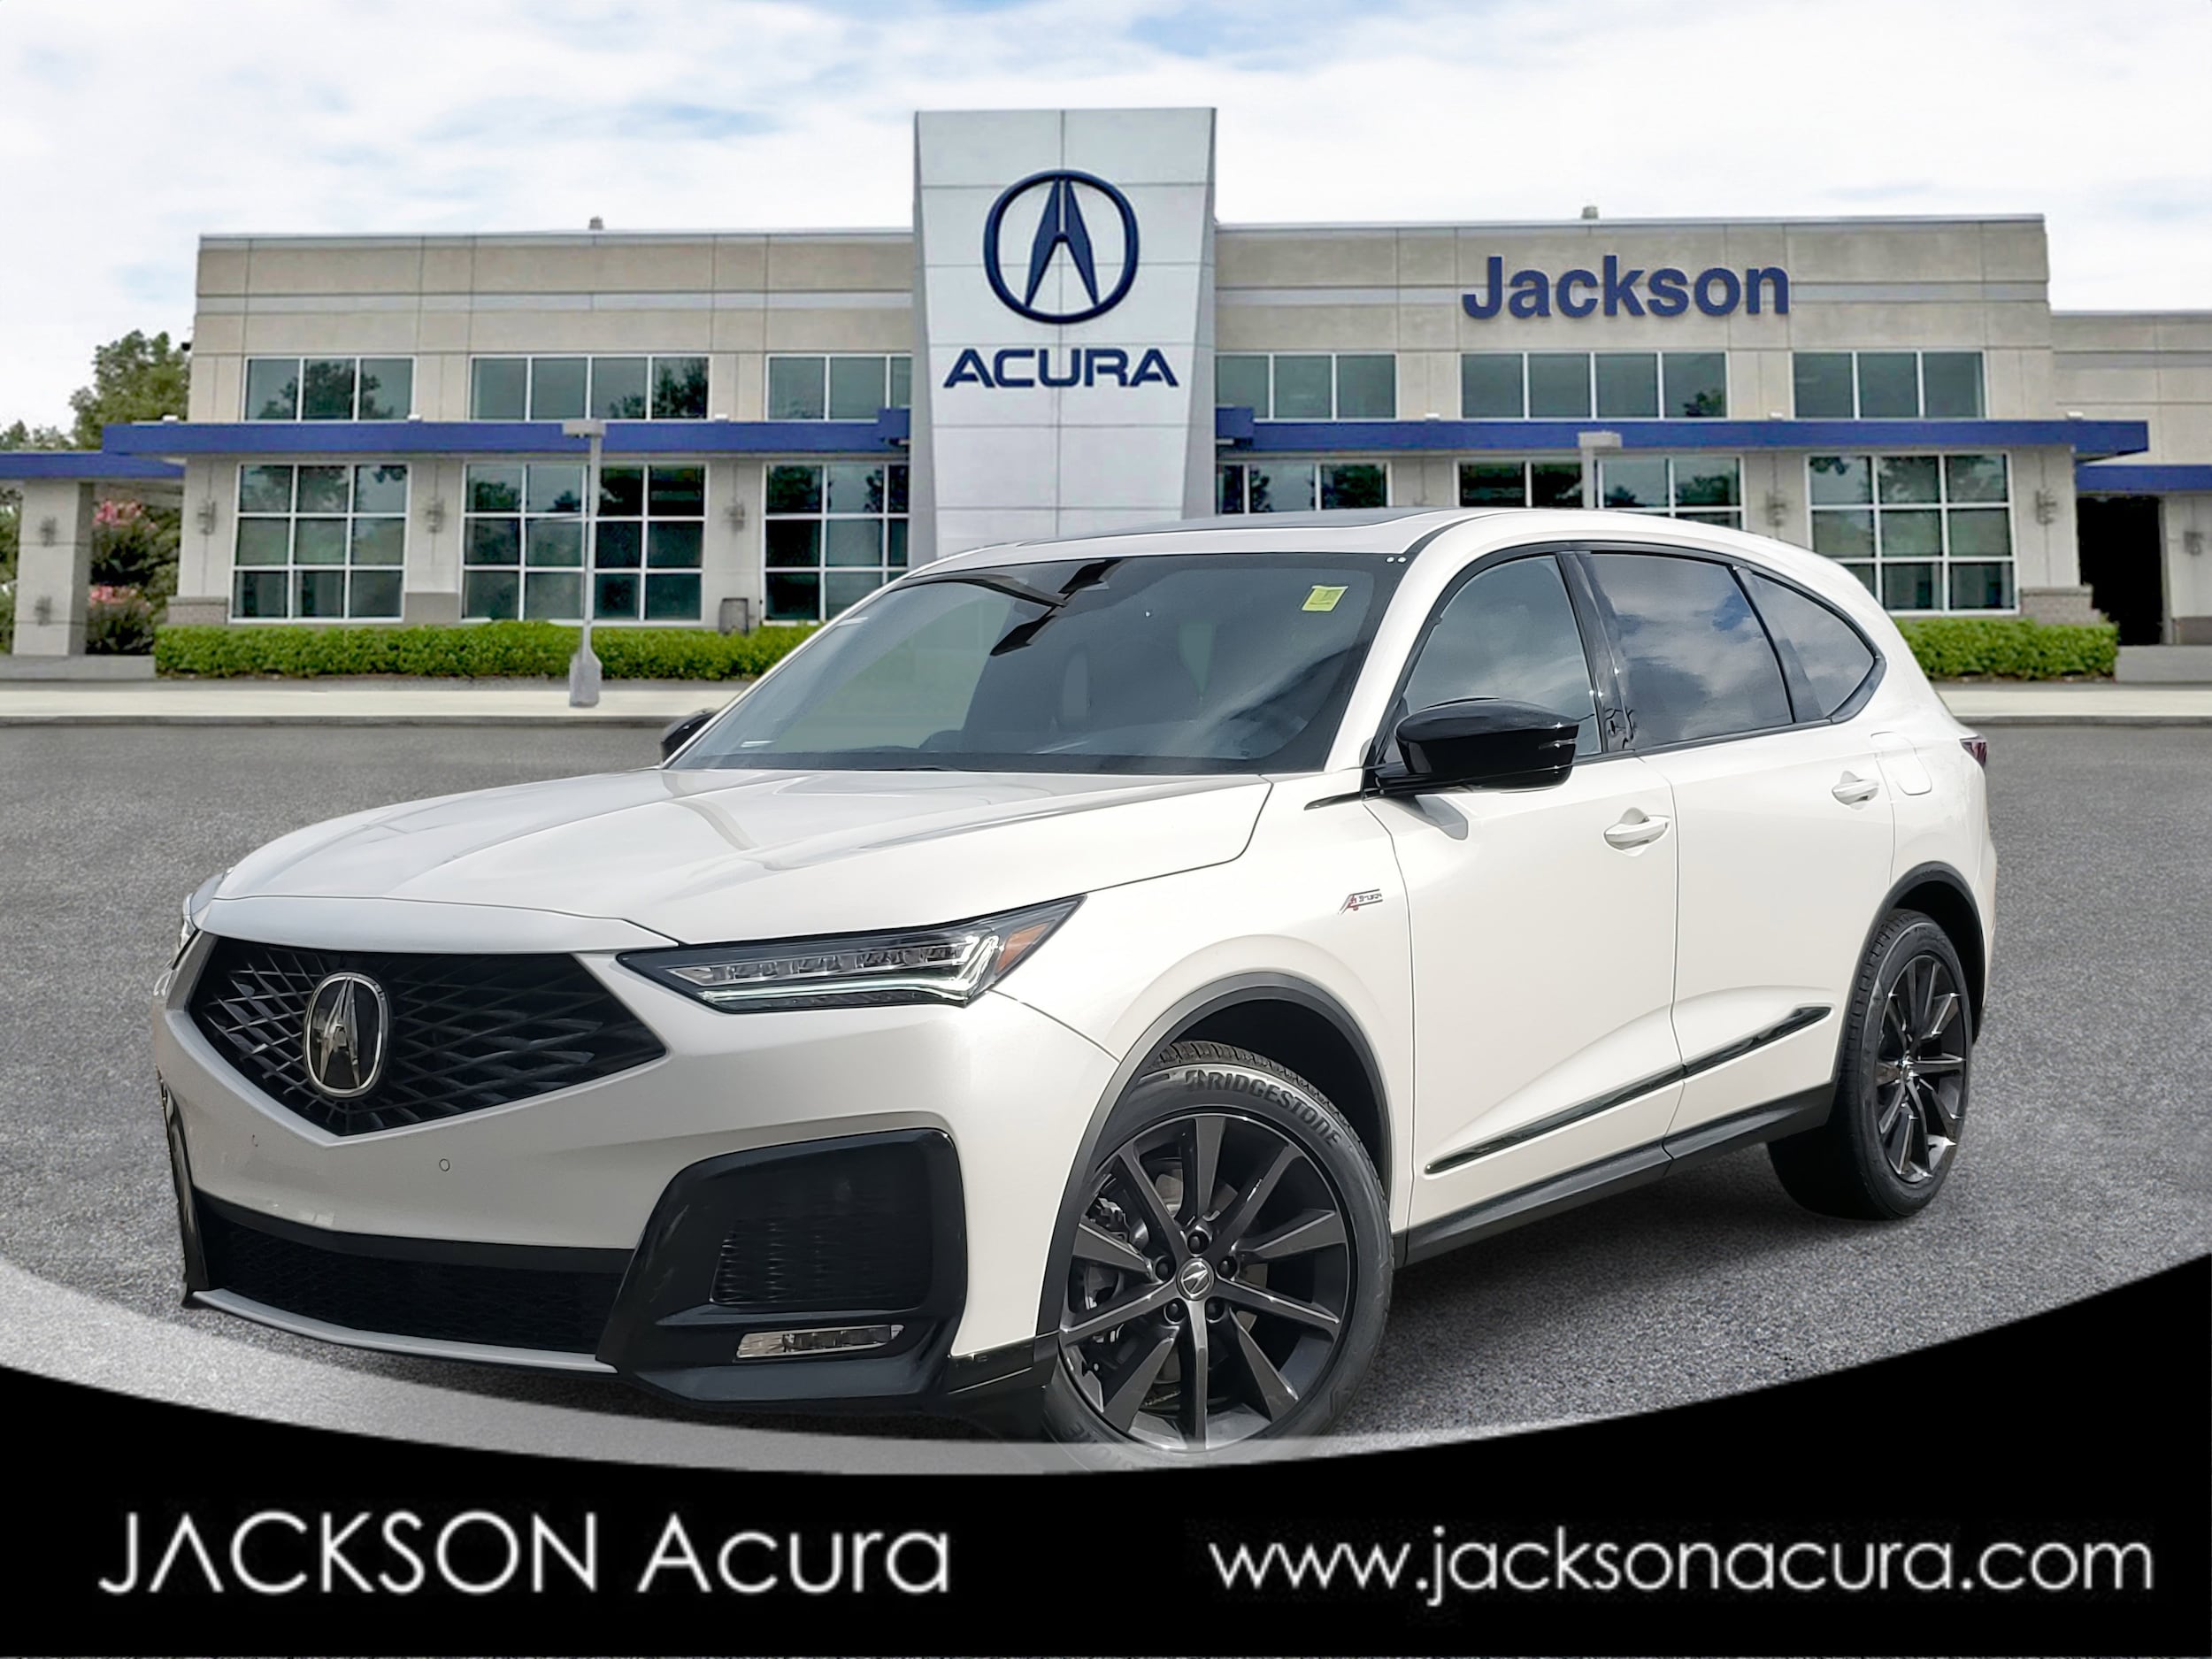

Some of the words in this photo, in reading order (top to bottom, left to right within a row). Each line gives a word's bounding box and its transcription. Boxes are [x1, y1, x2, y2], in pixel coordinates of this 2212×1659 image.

[1462, 255, 1790, 319] Jackson
[943, 348, 1179, 388] ACURA
[1185, 1069, 1343, 1148] BRIDGESTONE
